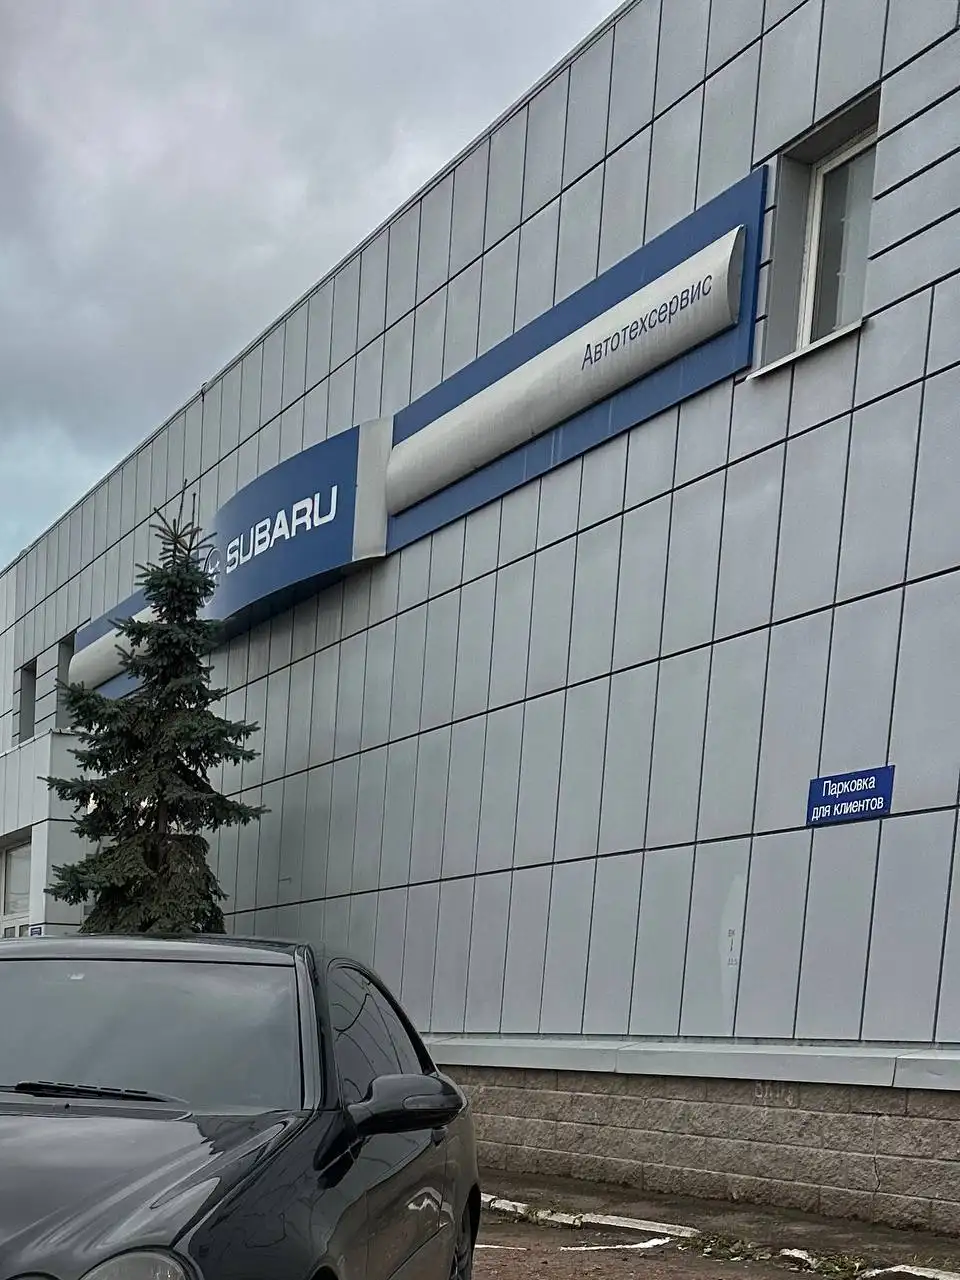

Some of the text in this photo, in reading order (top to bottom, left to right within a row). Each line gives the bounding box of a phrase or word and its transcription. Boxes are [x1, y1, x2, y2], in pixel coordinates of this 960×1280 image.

[581, 275, 712, 370] Автотехсервис
[226, 485, 338, 574] SUBARU
[812, 797, 884, 821] для клиентов
[822, 776, 876, 798] Парковка
